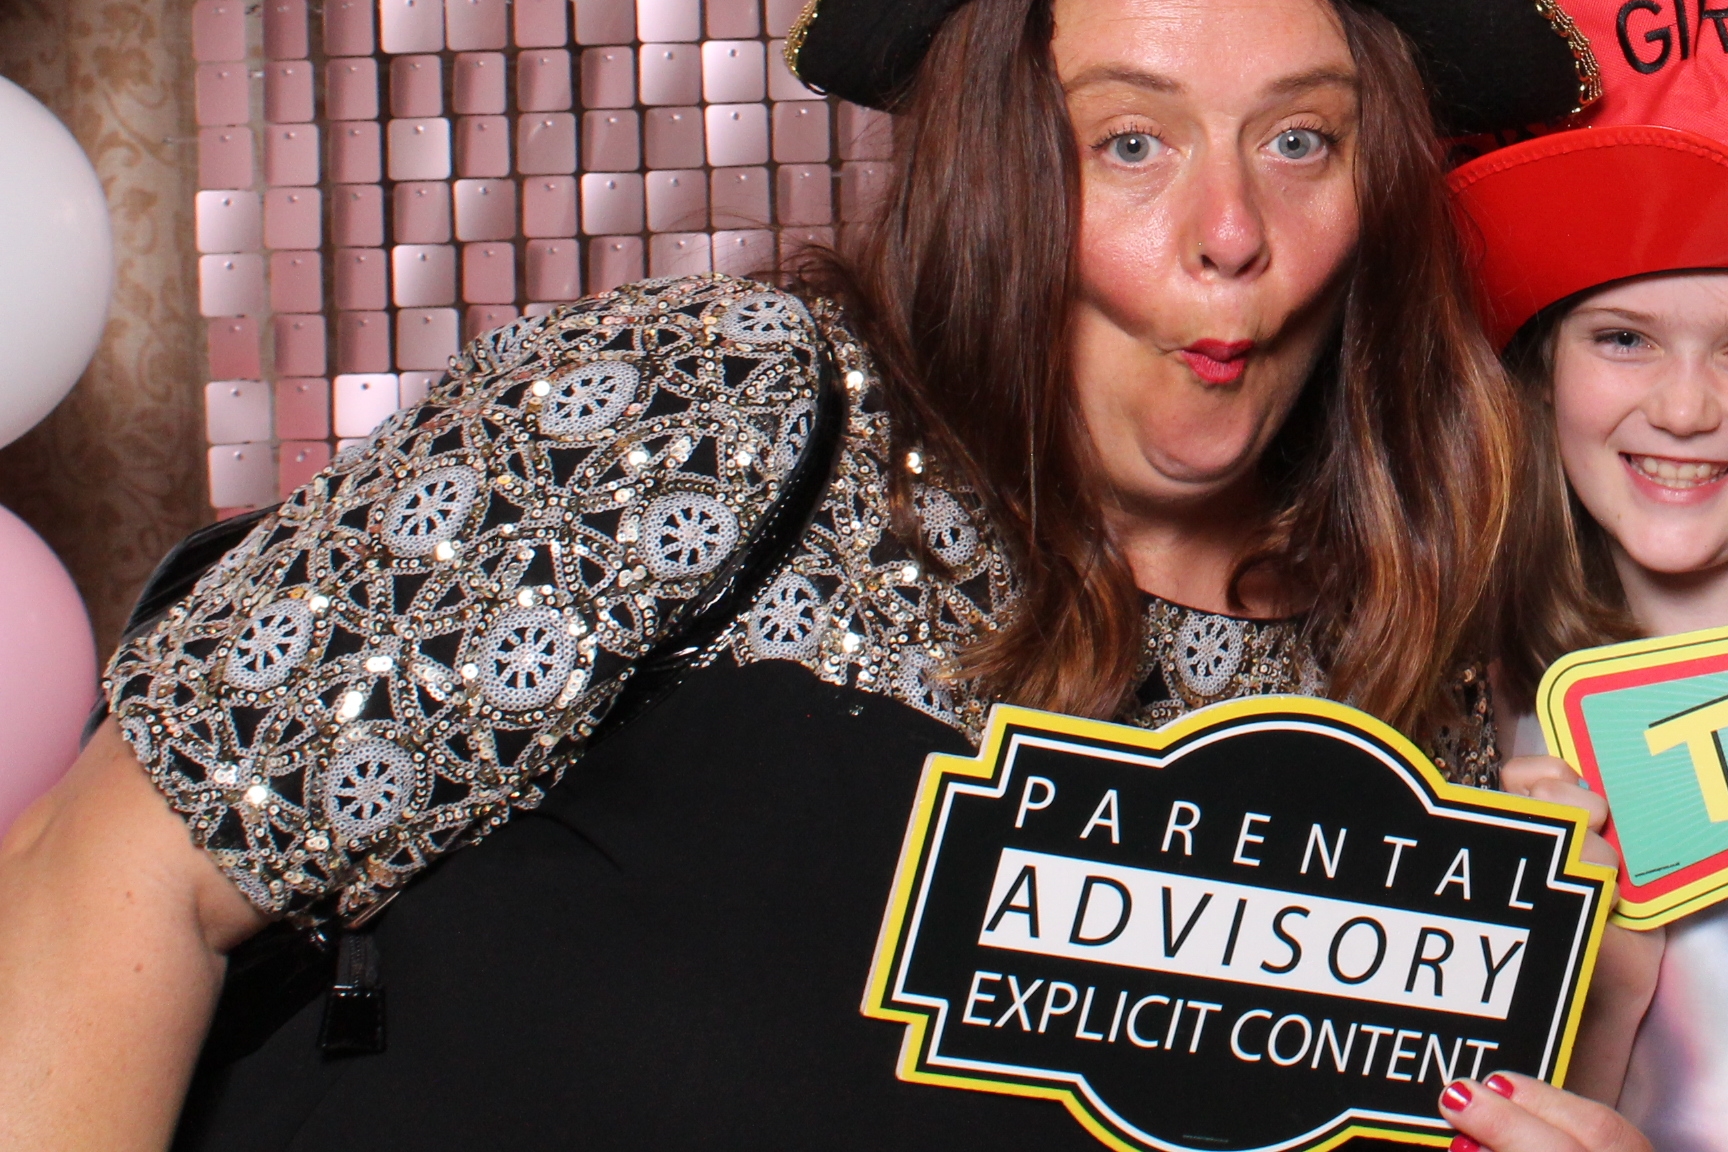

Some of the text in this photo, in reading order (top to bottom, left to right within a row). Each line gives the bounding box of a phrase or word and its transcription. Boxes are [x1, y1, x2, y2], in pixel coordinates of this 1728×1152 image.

[1015, 775, 1535, 911] PARENTAL
[984, 864, 1525, 1005] ADVISORY
[962, 970, 1499, 1087] EXPLICIT CONTENT
